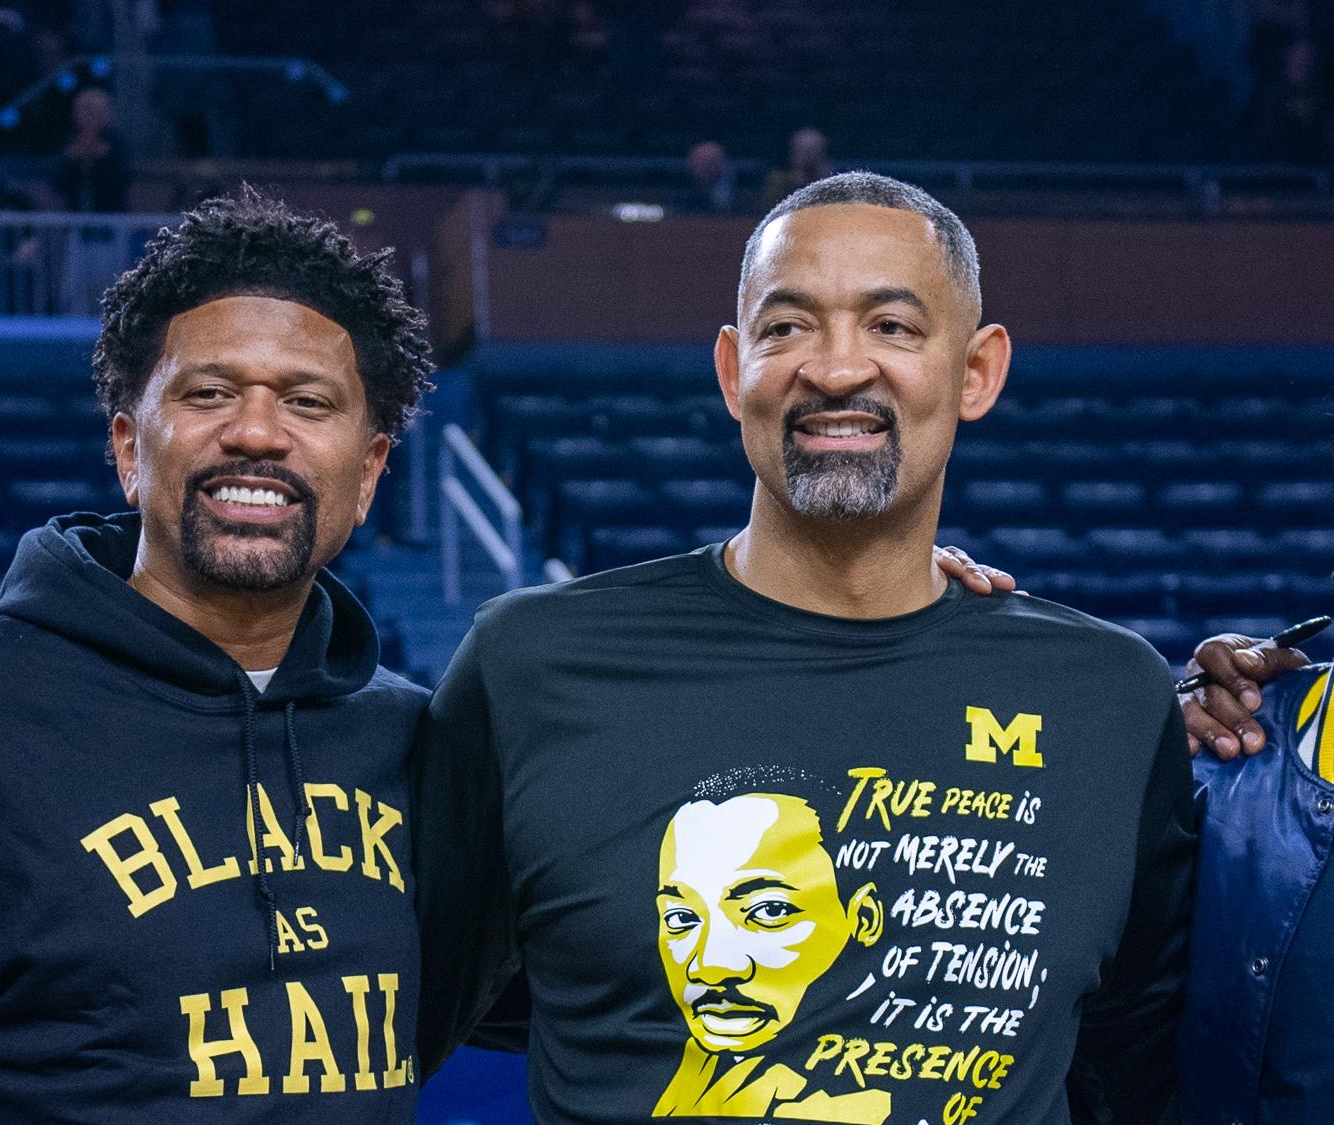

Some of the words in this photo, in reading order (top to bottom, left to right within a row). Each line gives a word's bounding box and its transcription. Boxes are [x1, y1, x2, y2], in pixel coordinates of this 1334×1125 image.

[965, 705, 1043, 768] M
[836, 766, 935, 833] TRUE
[940, 789, 1011, 822] PEACE
[79, 782, 405, 919] BLACK
[835, 838, 891, 868] NOT
[895, 834, 1014, 877] MERELY
[1014, 852, 1046, 877] THE
[275, 906, 329, 954] AS
[890, 891, 1046, 936] ABSENCE
[882, 943, 919, 979] OF
[179, 972, 407, 1098] HAIL
[958, 1006, 1024, 1037] THE
[805, 1034, 1014, 1088] PRESENCE
